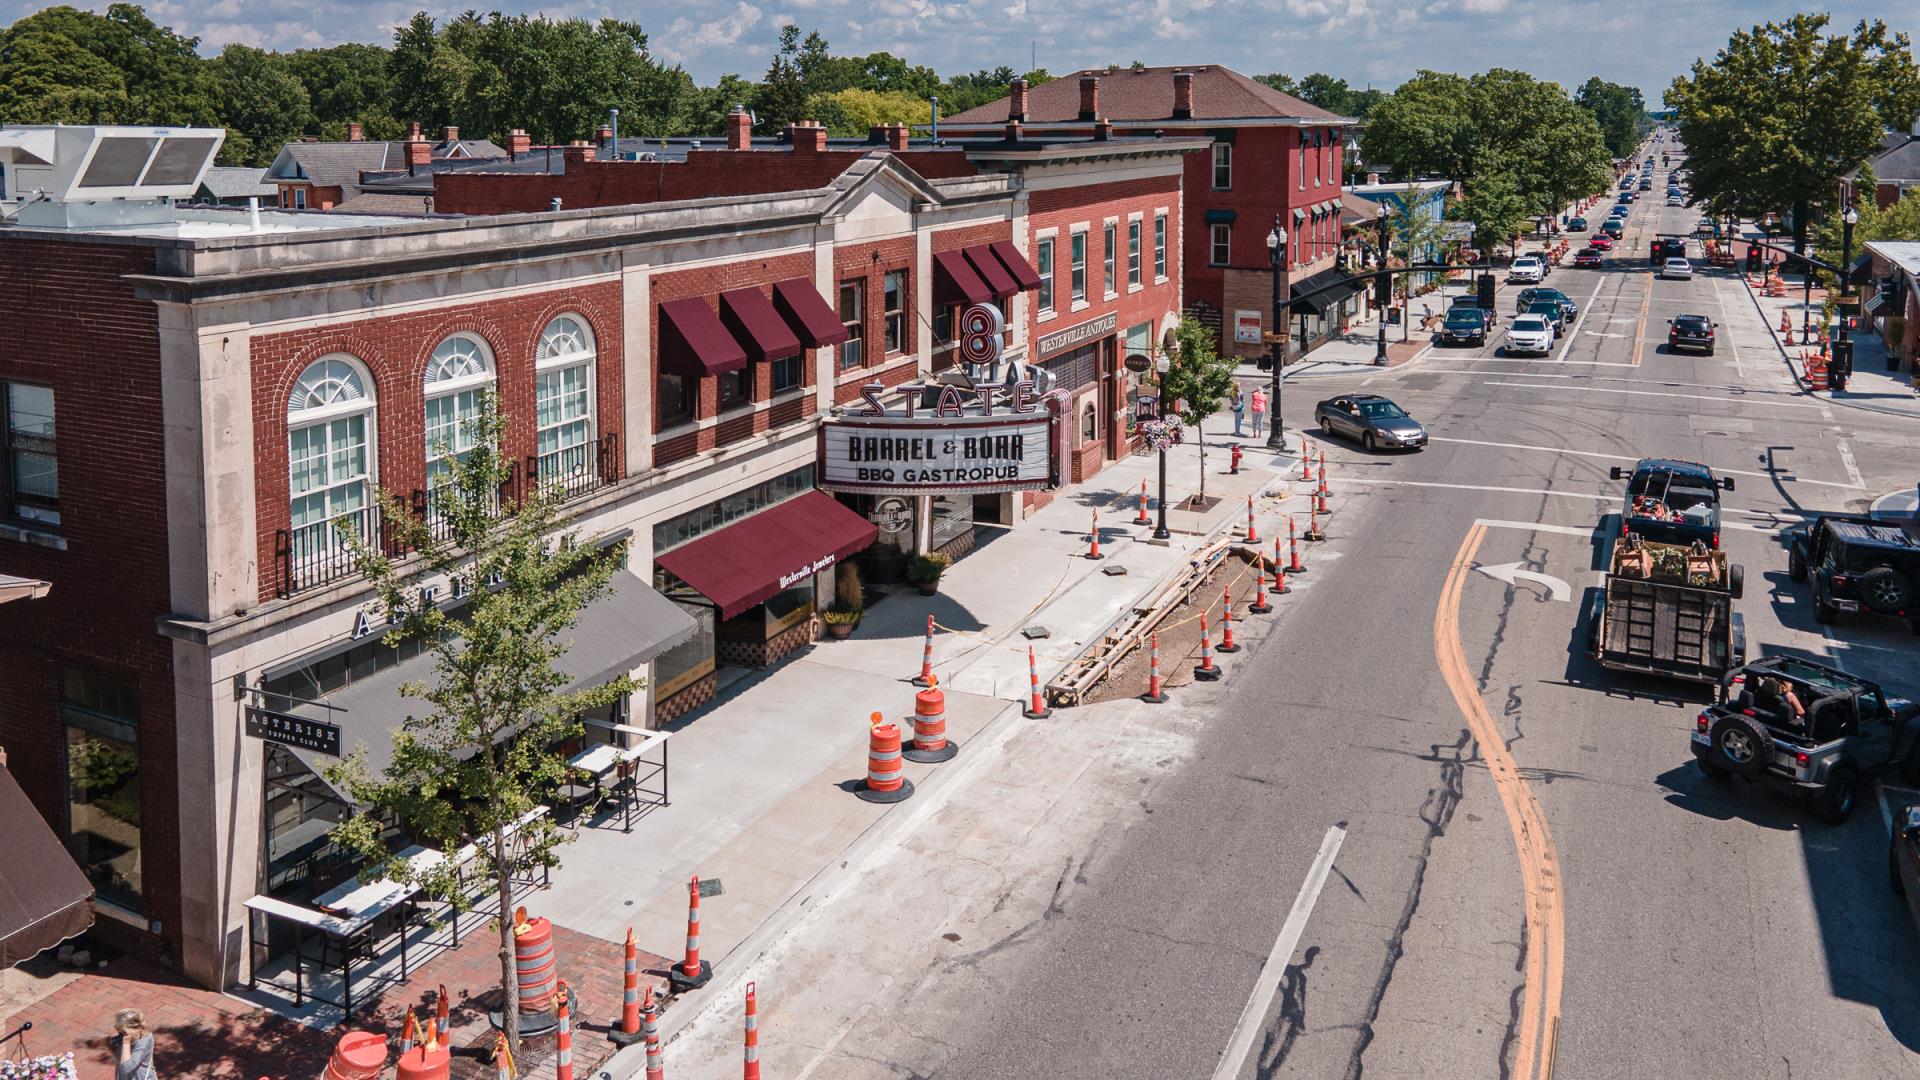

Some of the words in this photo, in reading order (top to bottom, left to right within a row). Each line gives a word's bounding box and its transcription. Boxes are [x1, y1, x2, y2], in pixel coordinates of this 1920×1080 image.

[962, 303, 1001, 364] 8
[1040, 326, 1086, 354] WESTERVILLE
[1086, 315, 1116, 338] ANTIQUES
[861, 380, 1036, 418] STATE
[849, 436, 937, 463] BARREL
[943, 440, 958, 455] &
[964, 434, 1023, 463] BOAR
[858, 467, 895, 482] BBQ
[903, 465, 1019, 483] GASTROPUB
[780, 565, 811, 589] Westerville
[812, 554, 835, 572] Jewelers
[250, 714, 335, 741] ASTERISK
[268, 730, 296, 742] SUPPER
[299, 738, 318, 748] CLUB
